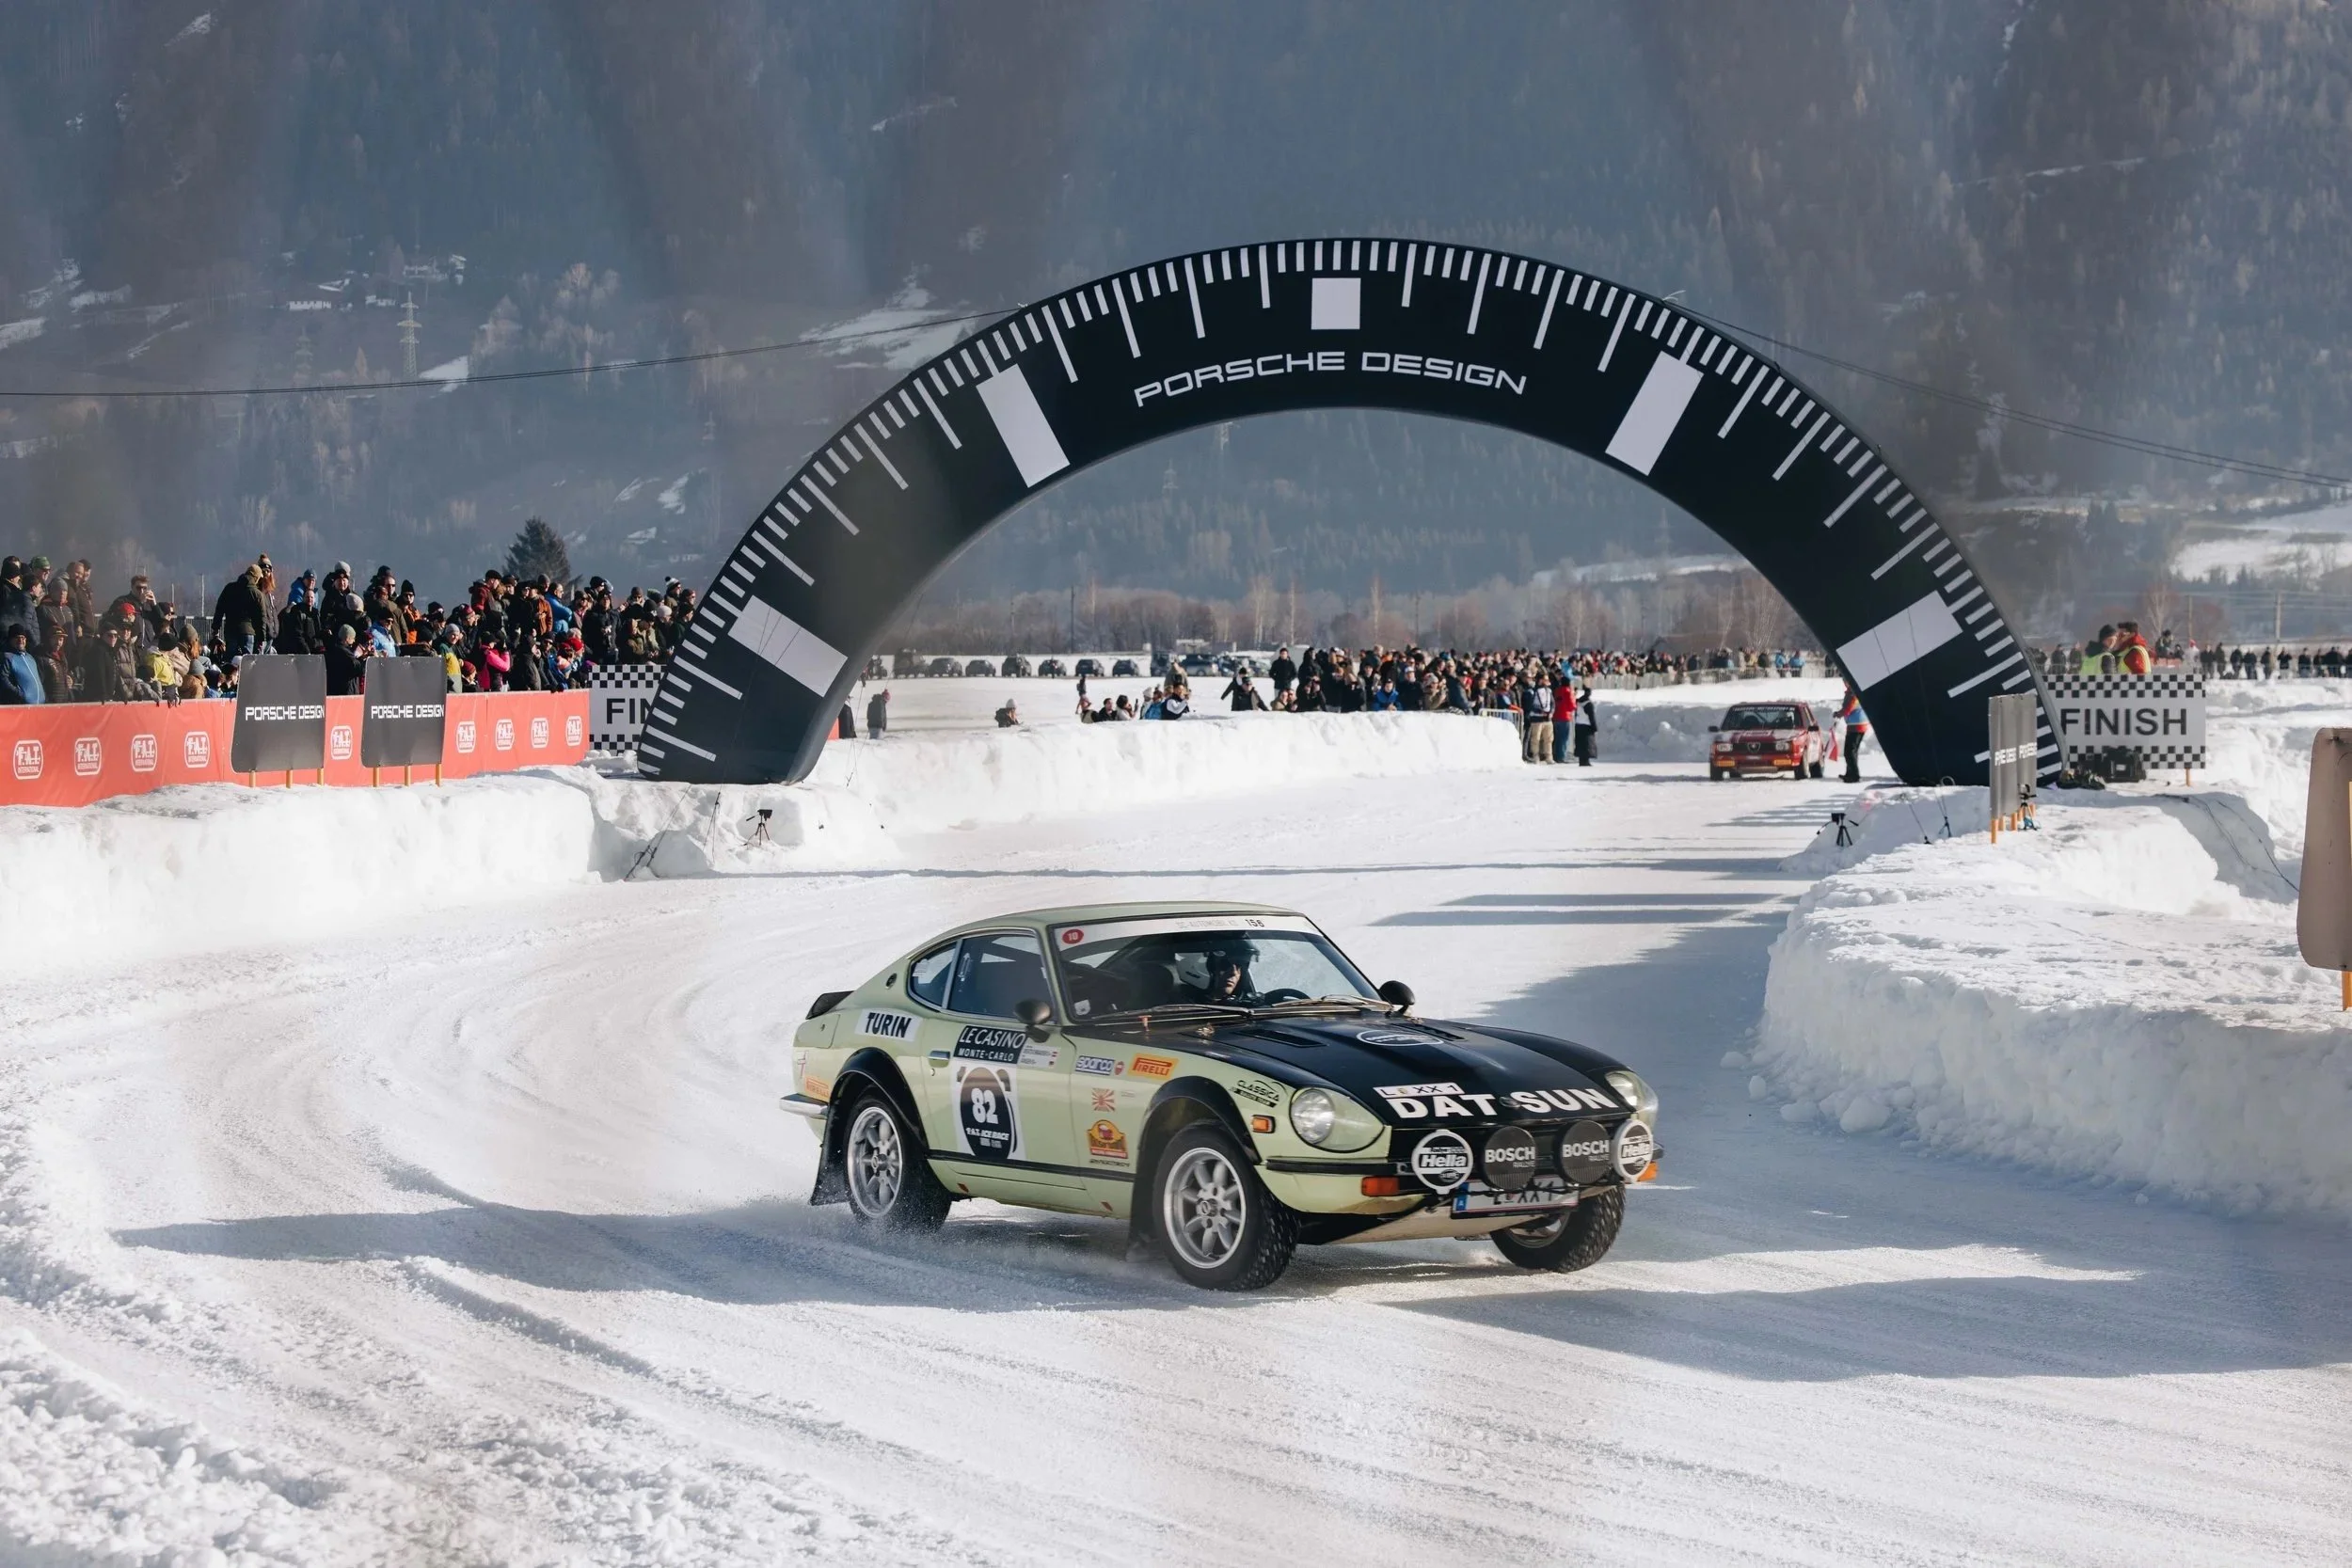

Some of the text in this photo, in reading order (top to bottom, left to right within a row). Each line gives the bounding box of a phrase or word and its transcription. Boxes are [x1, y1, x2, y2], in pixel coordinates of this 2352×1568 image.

[1135, 351, 1527, 407] PORSCHE DESIGN
[246, 705, 325, 721] PORSCHE DESIGN
[371, 704, 444, 720] PORSCHE DESIGN
[2060, 707, 2187, 736] FINISH
[1068, 932, 1078, 941] 10
[865, 1012, 913, 1038] TURIN
[959, 1027, 1026, 1050] LE CASINO
[958, 1047, 1014, 1062] MONTE-CARLO
[1076, 1057, 1114, 1071] sparco
[1133, 1057, 1173, 1076] PIRELLI
[1412, 1085, 1441, 1094] XX
[1447, 1085, 1459, 1093] 1
[971, 1087, 999, 1124] 82
[1386, 1087, 1620, 1118] DAT SUN
[1485, 1146, 1535, 1164] BOSCH
[1563, 1140, 1610, 1158] BOSCH
[1622, 1142, 1651, 1157] Hella
[1421, 1154, 1467, 1167] Hella
